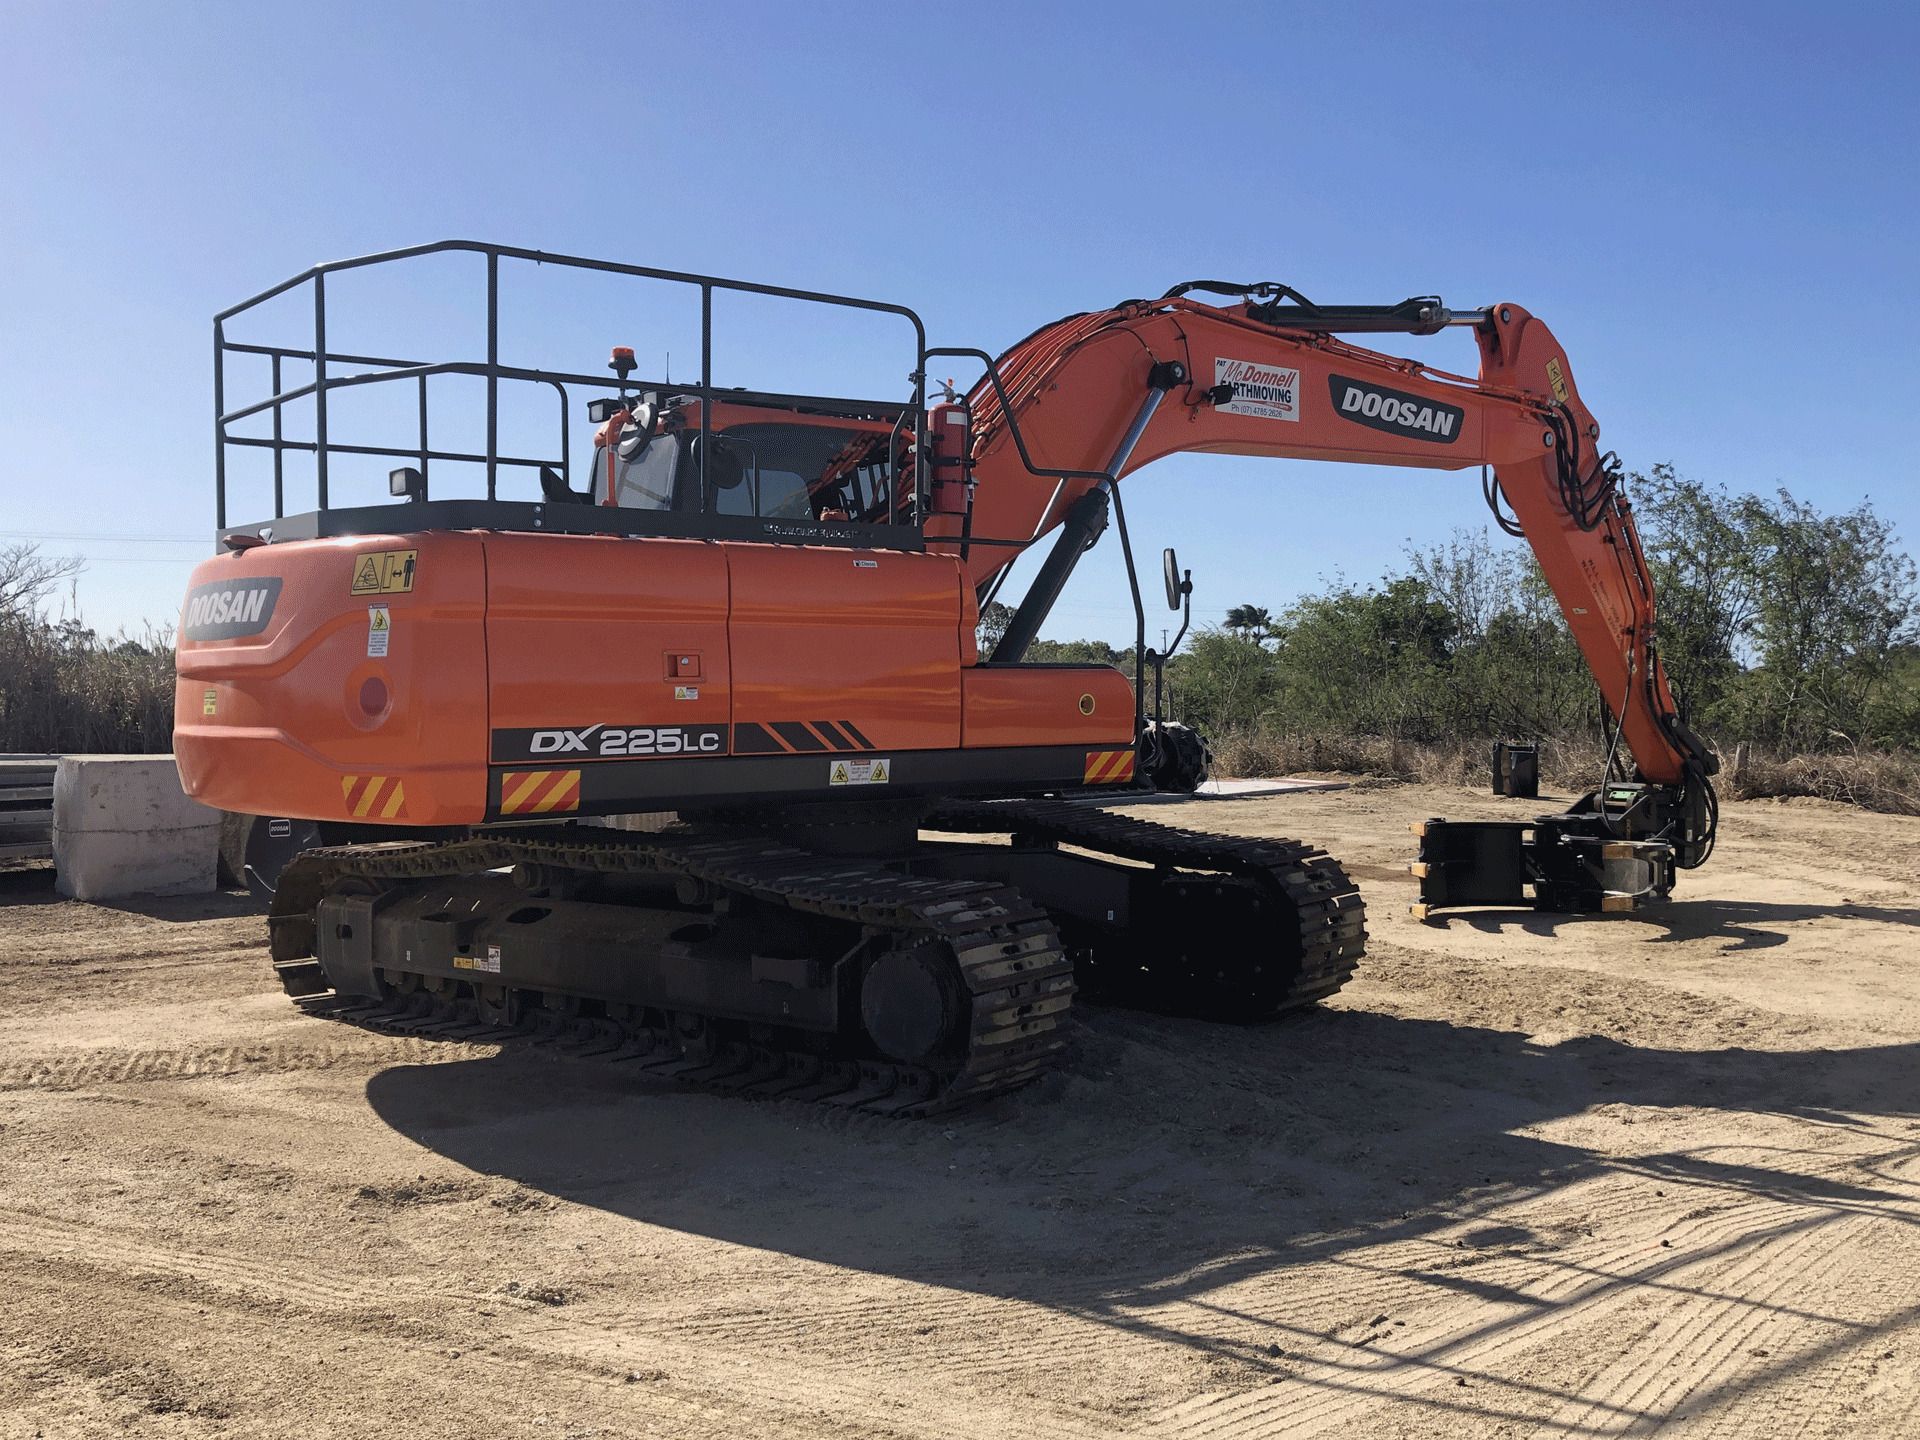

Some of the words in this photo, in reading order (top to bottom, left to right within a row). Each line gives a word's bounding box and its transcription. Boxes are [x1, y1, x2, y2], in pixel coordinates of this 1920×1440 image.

[1222, 361, 1297, 388] McDonnell
[1231, 404, 1239, 412] Ph
[1241, 405, 1252, 415] (07)
[1342, 386, 1455, 436] DOOSAN
[187, 589, 268, 628] DOOSAN
[530, 722, 606, 753] DX
